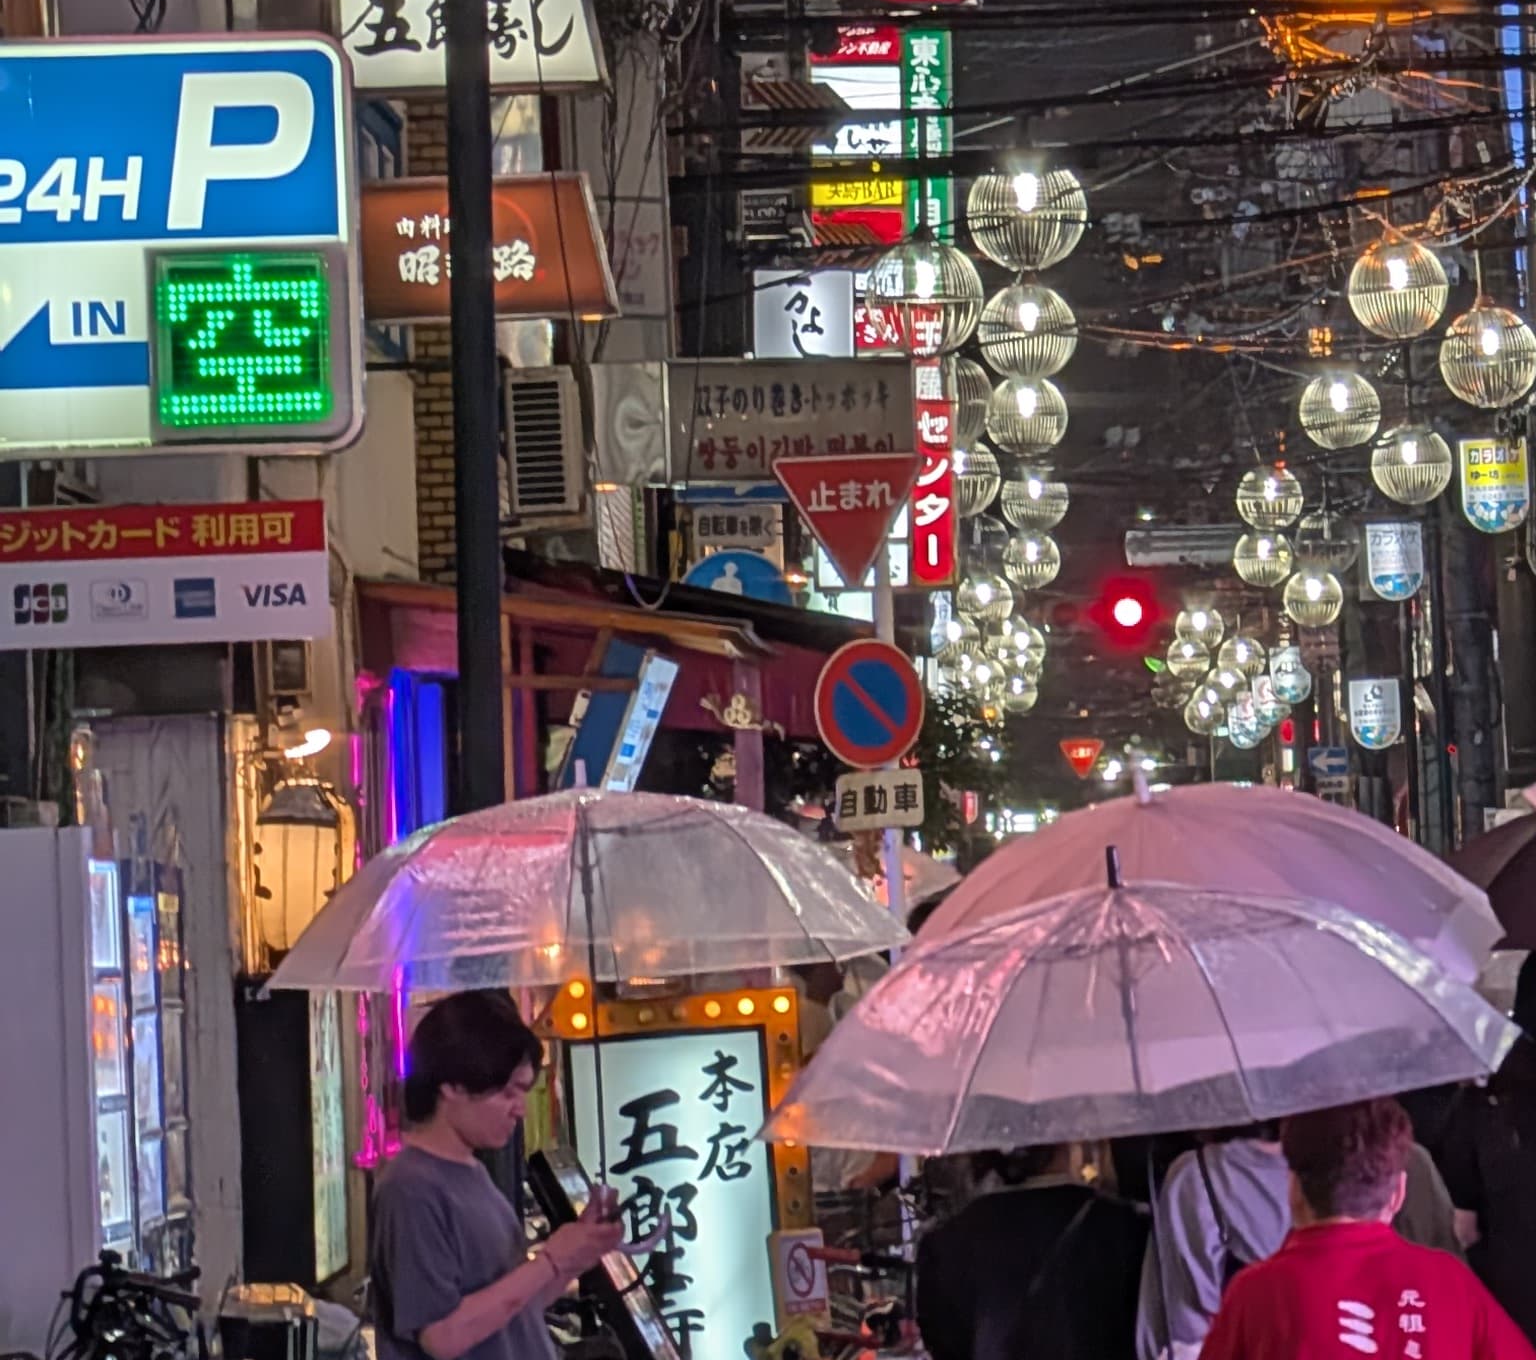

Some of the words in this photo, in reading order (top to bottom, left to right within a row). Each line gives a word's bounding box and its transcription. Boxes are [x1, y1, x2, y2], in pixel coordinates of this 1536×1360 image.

[166, 71, 315, 231] P
[398, 239, 536, 286] 昭路
[72, 300, 126, 337] IN
[158, 259, 329, 421] 空
[807, 480, 895, 513] 止まれ
[190, 511, 295, 548] 利用可
[243, 583, 307, 607] VISA
[839, 784, 920, 820] 自動車
[700, 1049, 755, 1182] 本店
